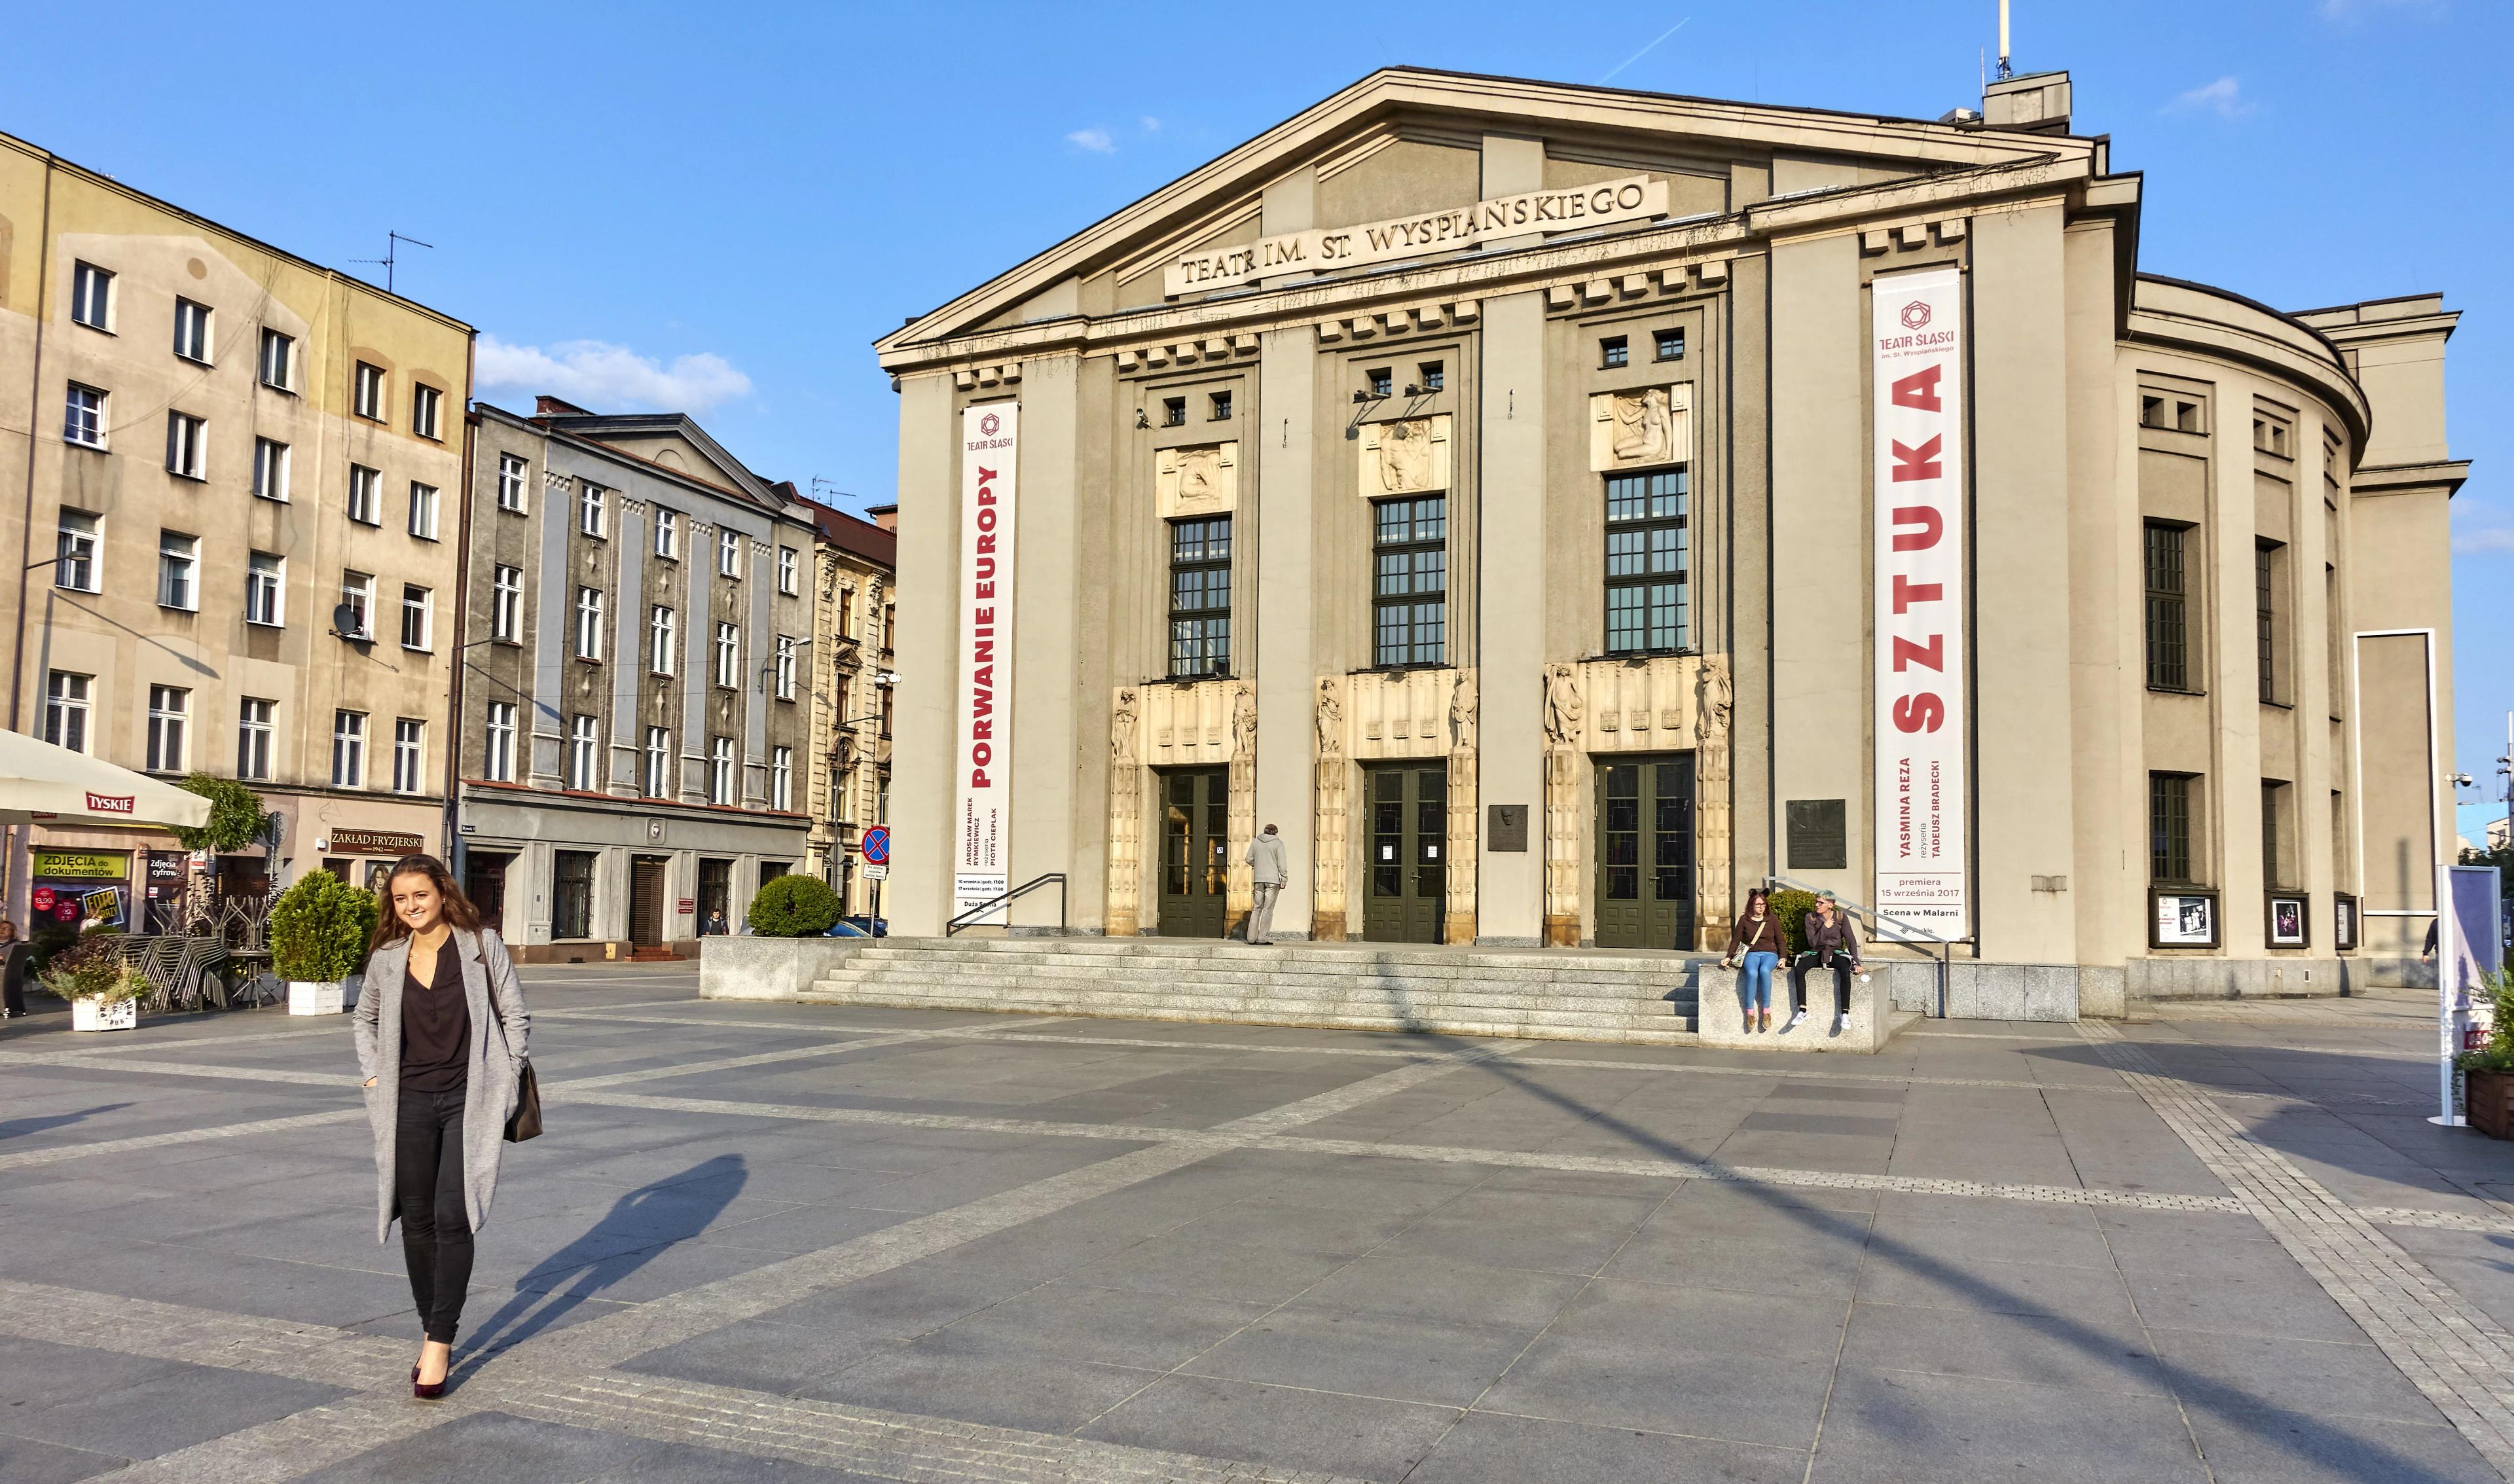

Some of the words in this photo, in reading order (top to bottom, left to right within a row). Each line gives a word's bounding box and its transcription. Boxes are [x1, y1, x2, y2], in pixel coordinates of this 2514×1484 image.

[1181, 249, 1256, 283] TEATR
[1264, 238, 1307, 266] IM.
[1321, 234, 1352, 259] ST.
[1366, 183, 1644, 252] WYSPIAŃSKIEGO
[1880, 336, 1913, 350] TEATR
[1903, 346, 1954, 357] Wyspiańskiego
[967, 441, 988, 451] TEATR
[975, 465, 998, 600] EUROPY
[1892, 363, 1944, 734] SZTUKA
[972, 606, 994, 787] PORWANIE
[1899, 757, 1910, 792] REZA
[1931, 760, 1940, 811] BRADECKI
[88, 795, 132, 811] TYSKIE
[1900, 796, 1910, 858] YASMINA
[332, 833, 371, 845] ZAKŁAD
[372, 835, 422, 848] FRYZJERSKI
[1932, 814, 1940, 859] TADEUSZ
[43, 856, 96, 868] ZDJĘCIA
[150, 860, 176, 869] Zdjęcia
[45, 866, 114, 877] dokumentów
[152, 869, 180, 878] cyfrow
[85, 890, 115, 909] FOTO
[1893, 889, 1935, 897] września
